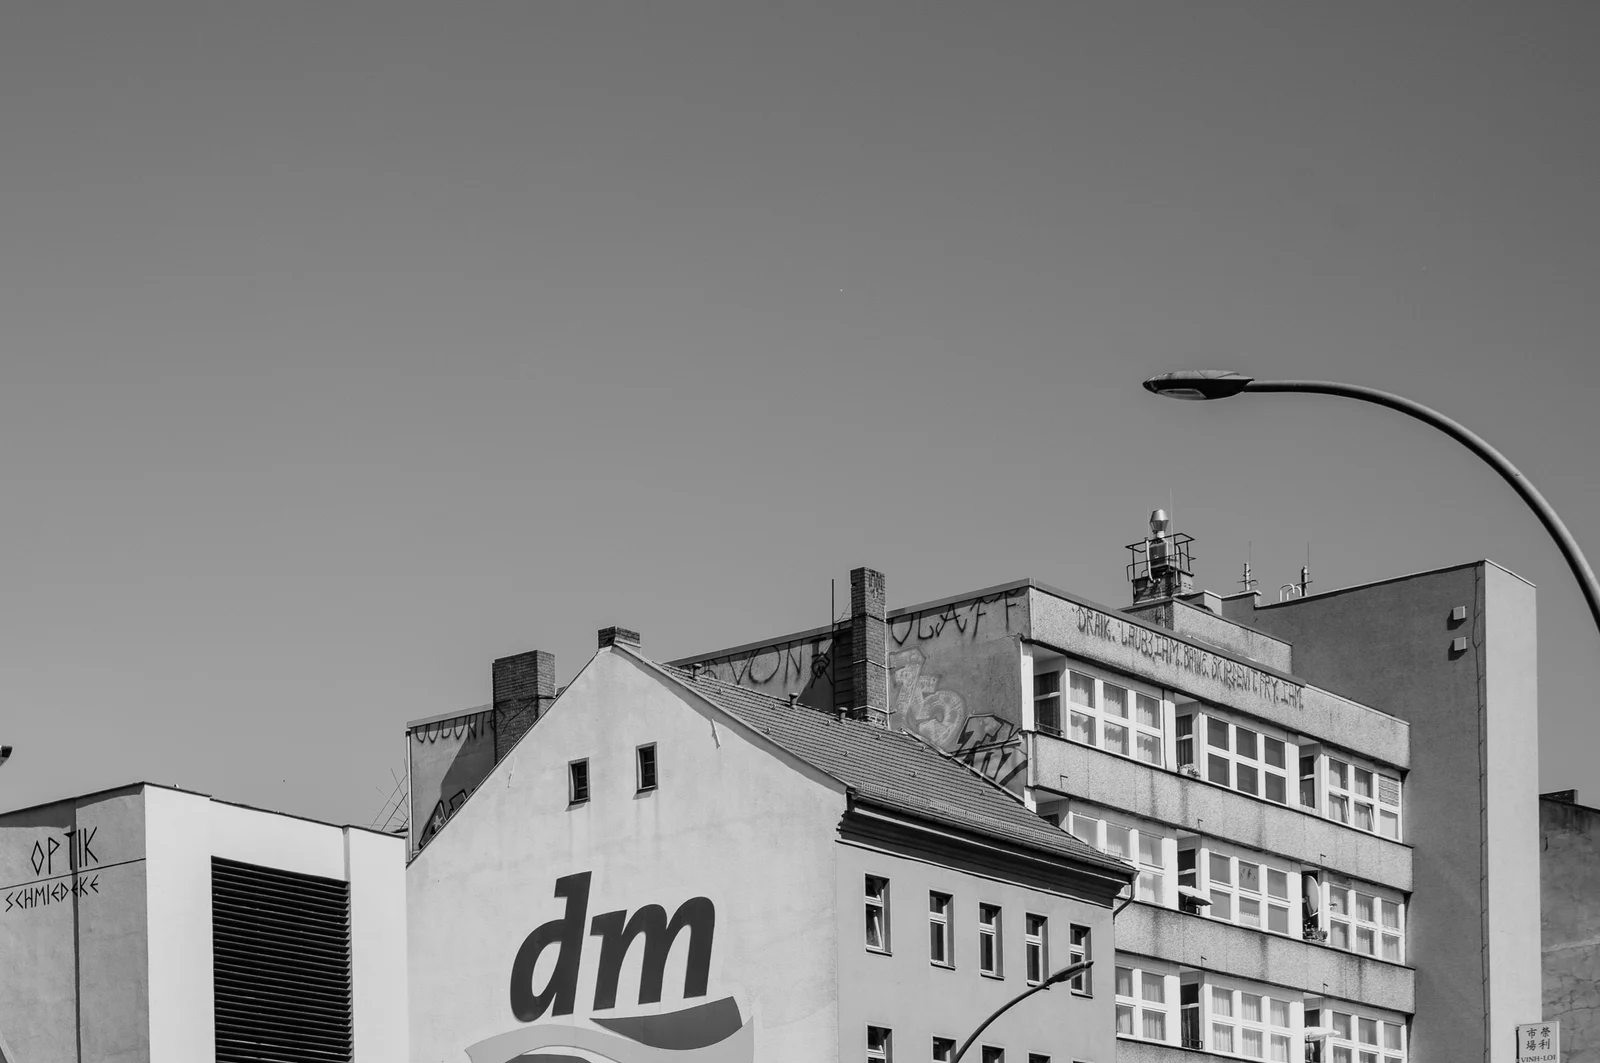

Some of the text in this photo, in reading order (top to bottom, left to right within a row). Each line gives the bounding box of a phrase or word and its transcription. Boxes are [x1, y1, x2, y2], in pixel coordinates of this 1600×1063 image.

[30, 826, 99, 876] OPTIK
[5, 874, 99, 912] SCHMIEDEKE
[509, 871, 715, 1023] dm
[1521, 1054, 1556, 1063] VINH-LOI
